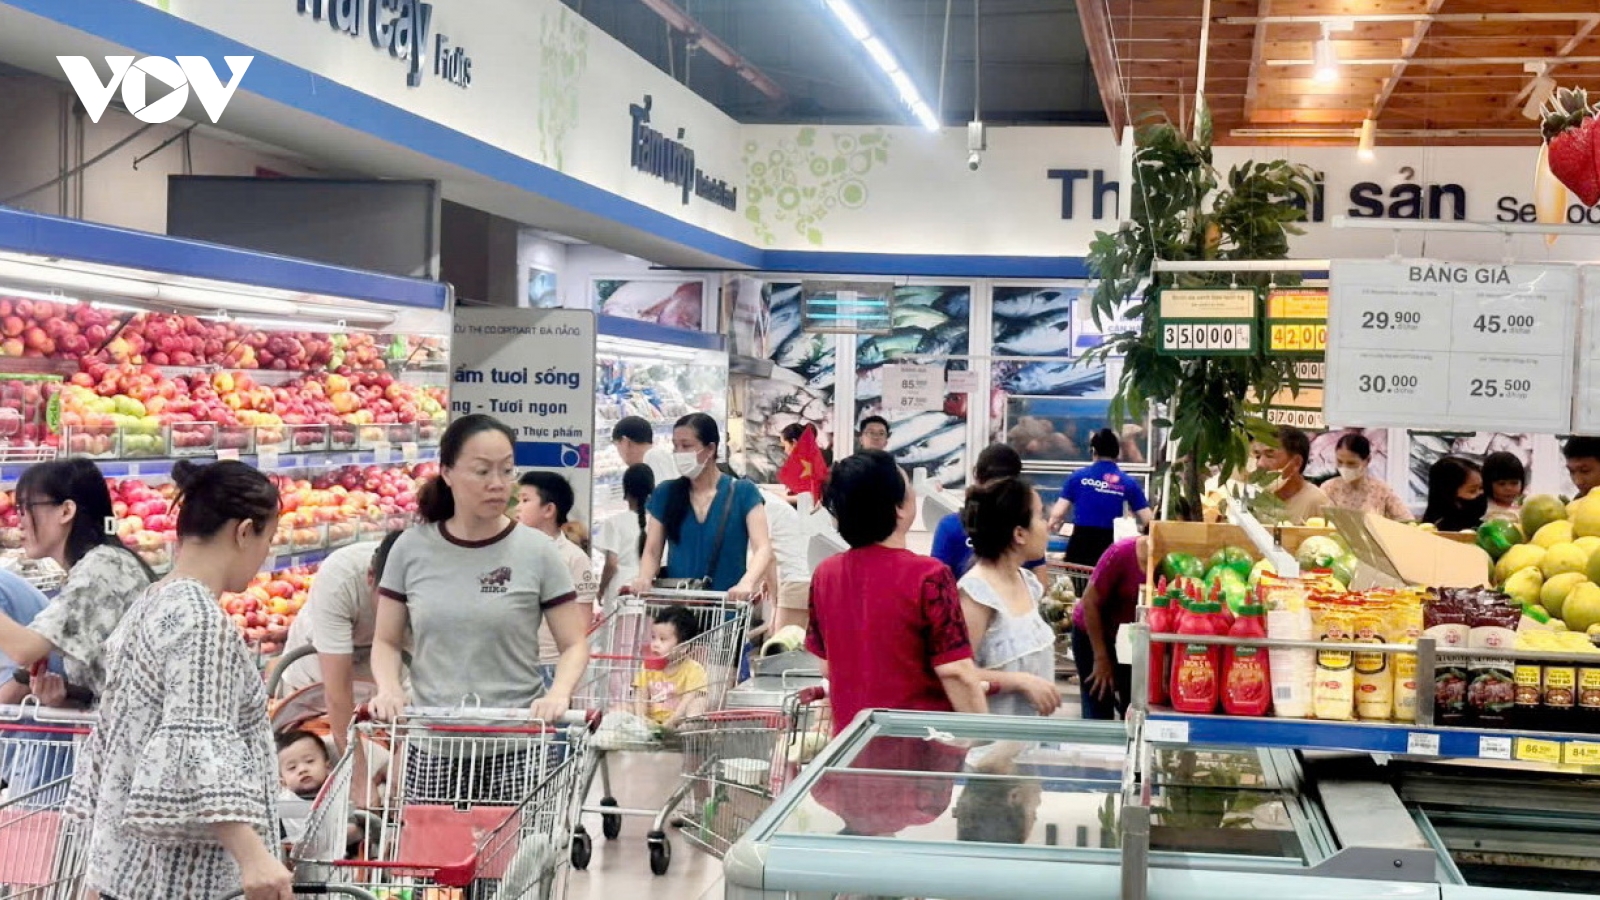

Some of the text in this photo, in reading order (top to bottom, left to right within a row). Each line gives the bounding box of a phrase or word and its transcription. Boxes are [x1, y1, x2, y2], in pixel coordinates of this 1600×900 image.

[1348, 166, 1467, 220] sản
[1475, 265, 1511, 284] GIÁ
[1165, 327, 1232, 344] 35.000
[534, 366, 580, 389] sống
[529, 402, 567, 416] ngon
